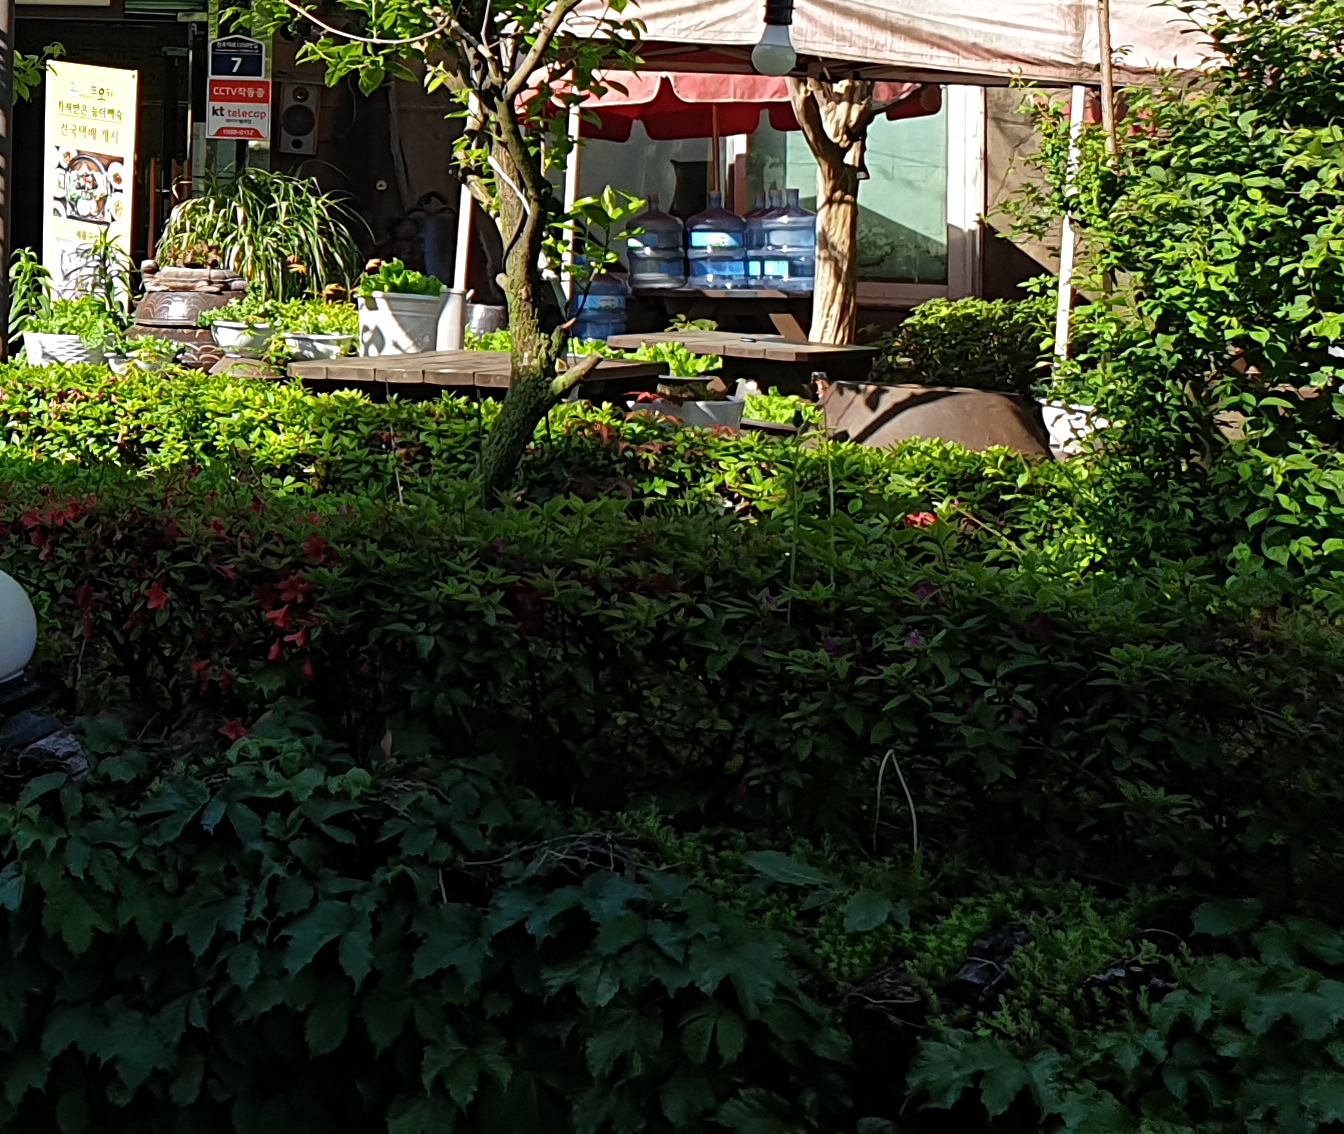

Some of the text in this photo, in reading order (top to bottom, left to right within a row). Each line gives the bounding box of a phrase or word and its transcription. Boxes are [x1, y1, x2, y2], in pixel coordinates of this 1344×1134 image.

[230, 57, 243, 73] 7
[213, 86, 266, 98] CCTV작동중
[212, 106, 267, 120] kt telecop
